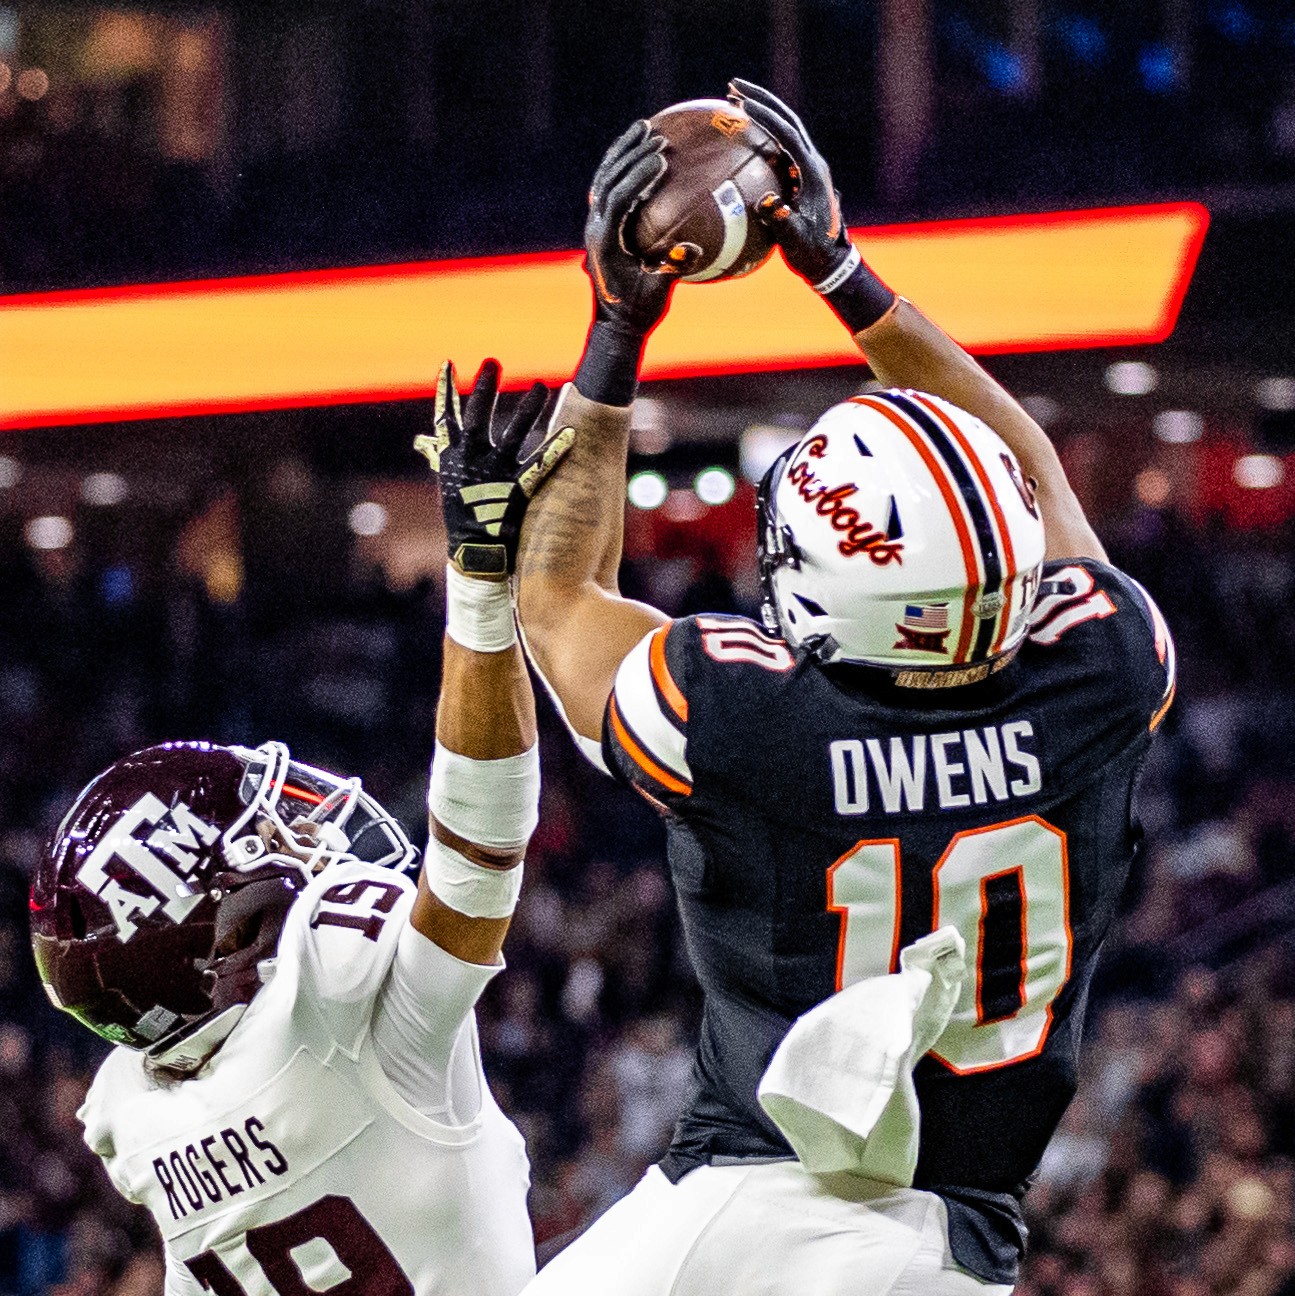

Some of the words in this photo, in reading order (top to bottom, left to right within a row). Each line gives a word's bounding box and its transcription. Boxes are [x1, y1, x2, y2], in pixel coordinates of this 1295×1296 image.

[787, 433, 905, 567] Cowboys
[695, 616, 797, 673] 10
[829, 719, 1042, 816] OWENS
[309, 879, 405, 942] 19
[826, 814, 1073, 1076] 10
[152, 1115, 288, 1220] ROGERS
